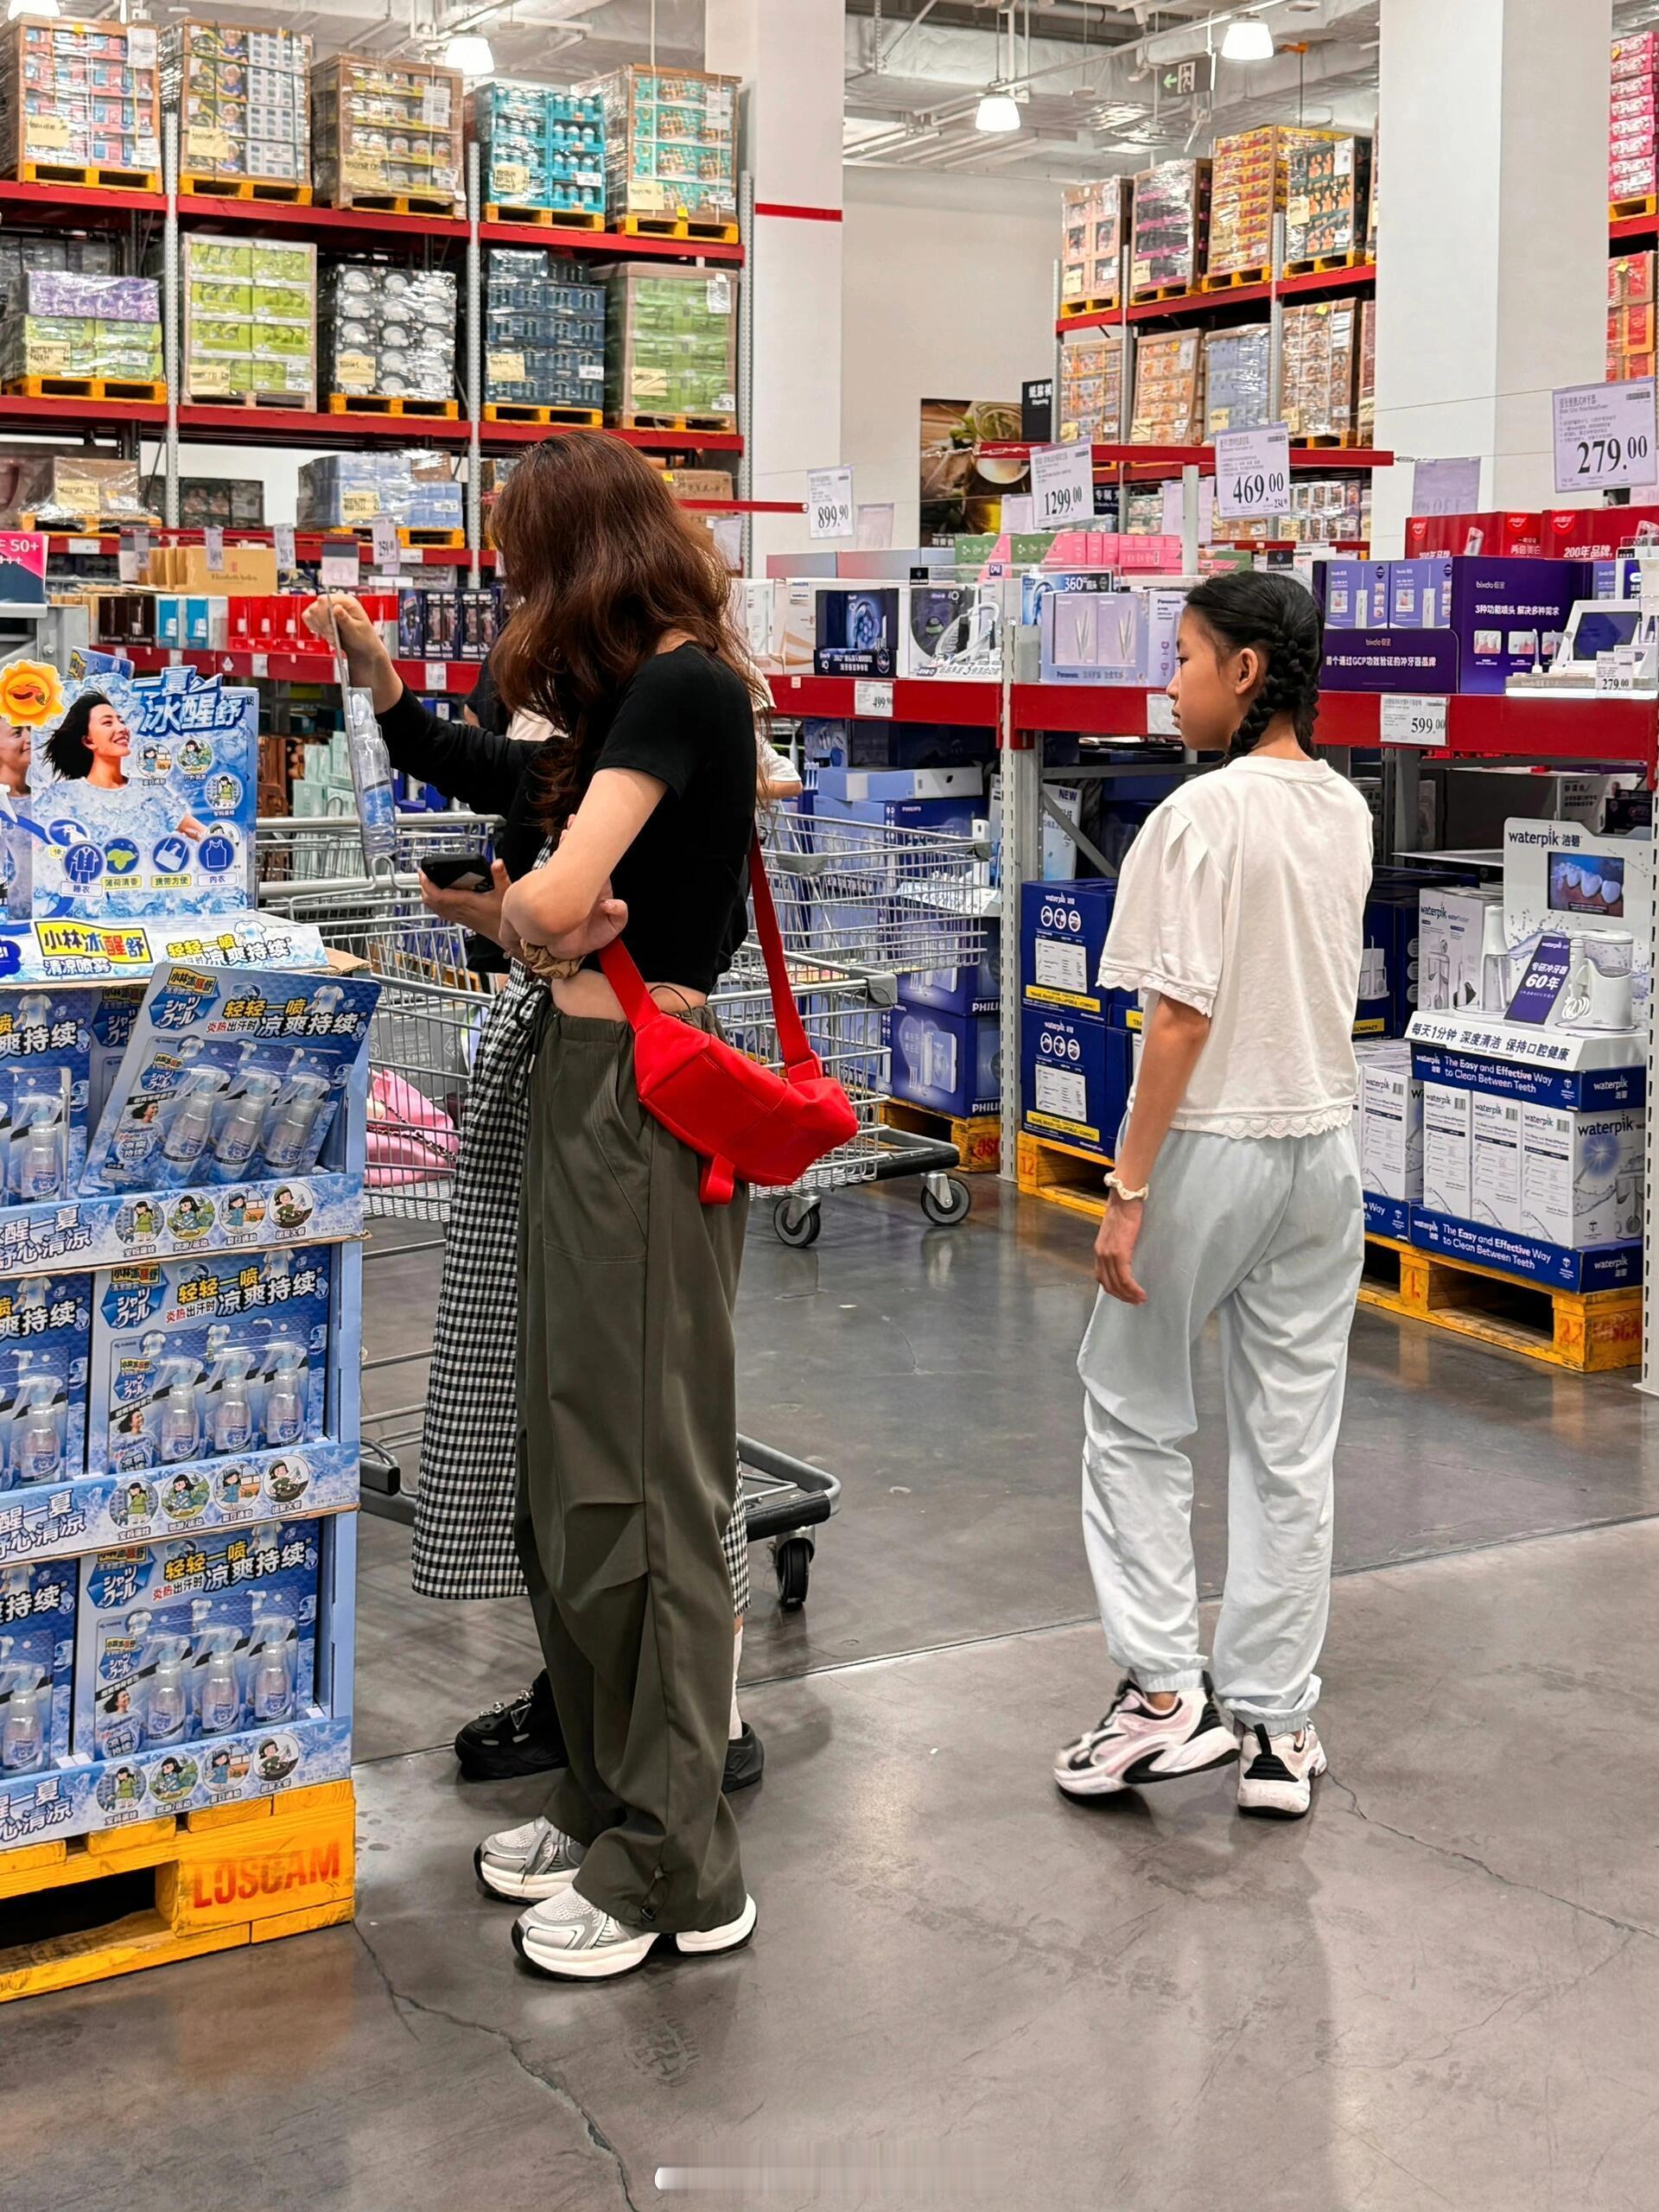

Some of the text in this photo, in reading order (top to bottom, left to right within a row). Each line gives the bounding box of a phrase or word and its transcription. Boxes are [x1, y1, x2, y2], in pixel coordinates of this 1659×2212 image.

[1577, 435, 1648, 474] 279.00
[1045, 486, 1082, 516] 1299.00
[1233, 473, 1284, 504] 469.00
[818, 505, 849, 528] 899.90
[10, 539, 39, 552] 50+
[1602, 678, 1629, 690] 279.00
[1411, 717, 1445, 734] 599.00
[1058, 789, 1077, 802] NEW
[1509, 825, 1559, 848] waterpik
[44, 929, 145, 957] 小林冰醒舒
[1526, 974, 1560, 990] 60年
[223, 998, 308, 1020] 轻轻一喷
[972, 1001, 1001, 1013] PHILI
[254, 1012, 359, 1039] 凉爽持续
[1411, 1023, 1570, 1061] 每天1分钟 深度清洁 保持口腔健康
[1445, 1055, 1553, 1086] The Easy and Effective Way
[1445, 1068, 1537, 1093] to Clean Between Teeth
[972, 1102, 1001, 1113] PHILI
[1578, 1111, 1634, 1136] waterpik
[1370, 1202, 1385, 1216] Way
[0, 1204, 79, 1247] 醒一夏
[1442, 1224, 1552, 1264] The Easy and Effective Way
[1442, 1236, 1535, 1269] to Clean Between Teeth
[177, 1267, 258, 1304] 轻轻一喷
[217, 1270, 317, 1316] 凉爽持续
[118, 1286, 150, 1312] シャツ
[165, 1300, 216, 1324] 炎热出汗时
[118, 1303, 150, 1329] クール
[165, 1541, 247, 1581] 轻轻一喷
[204, 1542, 305, 1592] 凉爽持续
[104, 1566, 137, 1588] シャツ
[153, 1576, 203, 1601] 炎热出汗时
[0, 1585, 61, 1623] 持续
[103, 1582, 137, 1609] クール
[194, 1841, 340, 1909] LOSCAM
